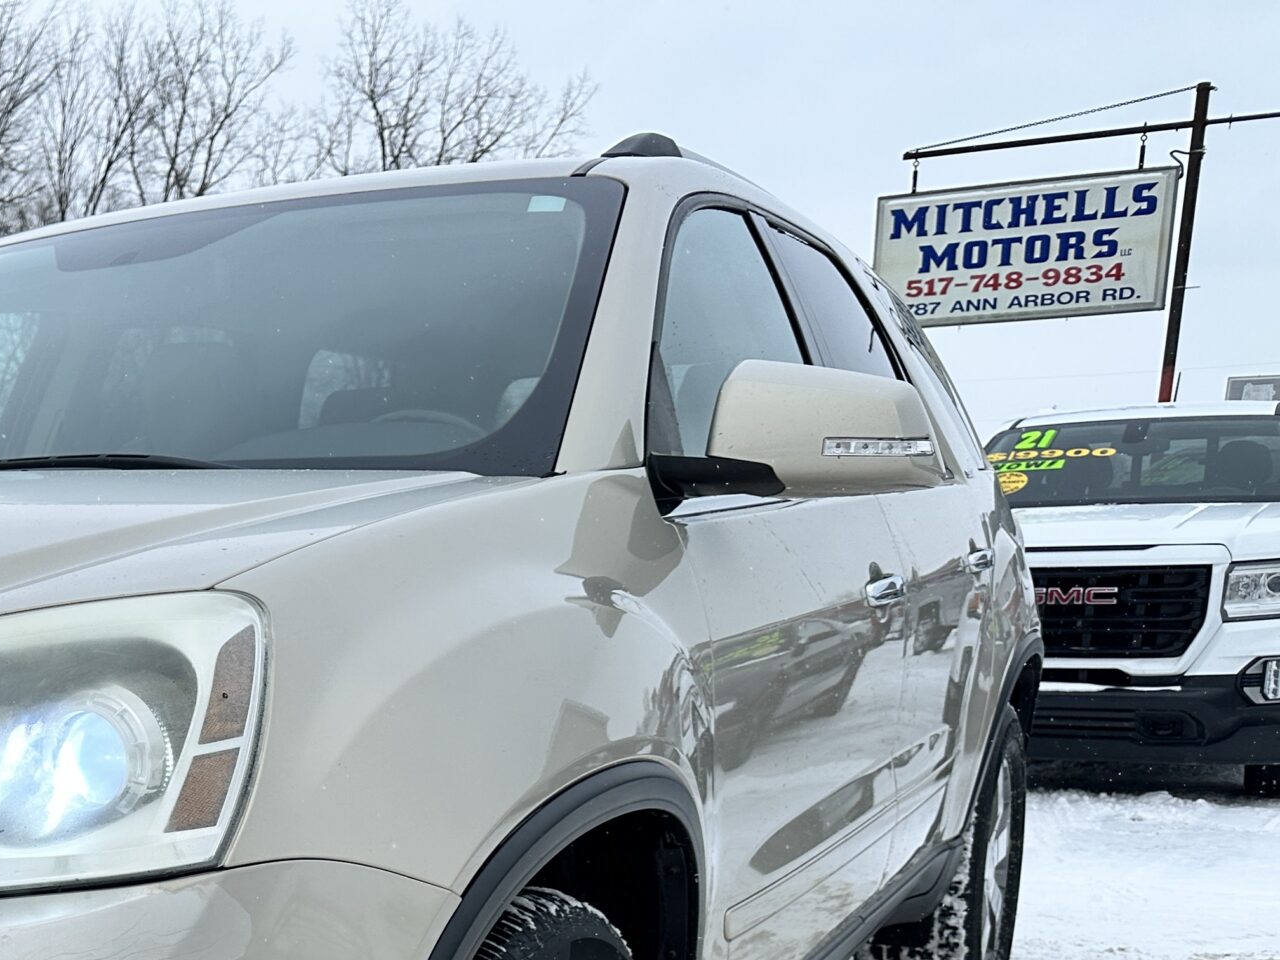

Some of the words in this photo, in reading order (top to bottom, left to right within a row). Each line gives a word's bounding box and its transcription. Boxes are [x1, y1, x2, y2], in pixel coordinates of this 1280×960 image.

[889, 182, 1159, 239] MITCHELLS
[918, 227, 1120, 274] MOTORS
[905, 262, 1126, 298] 517-748-9834
[949, 297, 998, 313] ANN
[1007, 290, 1090, 309] ARBOR
[1101, 286, 1141, 302] RD.
[986, 447, 1117, 462] $19900
[1014, 429, 1057, 449] 21
